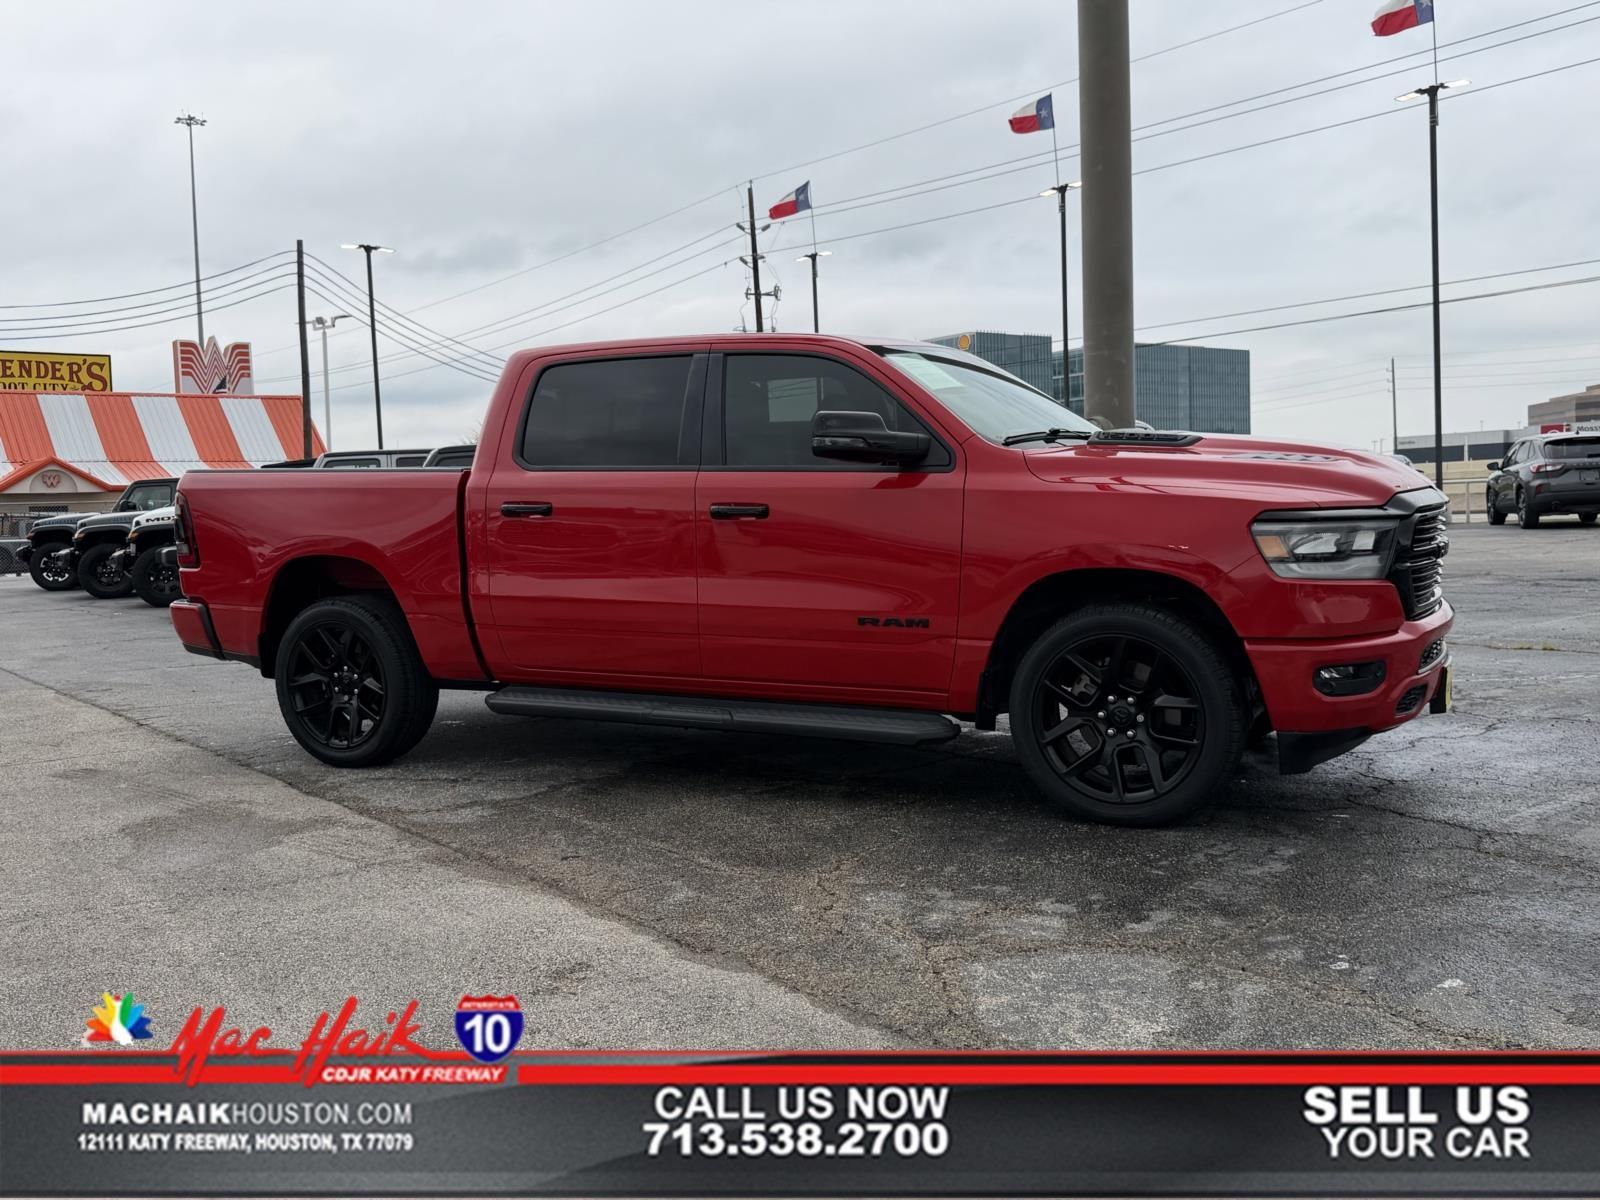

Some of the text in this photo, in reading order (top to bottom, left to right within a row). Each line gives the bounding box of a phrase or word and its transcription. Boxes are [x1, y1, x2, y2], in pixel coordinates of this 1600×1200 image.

[0, 358, 108, 392] ENDER'S
[33, 382, 68, 391] CITY
[857, 616, 930, 628] RAM
